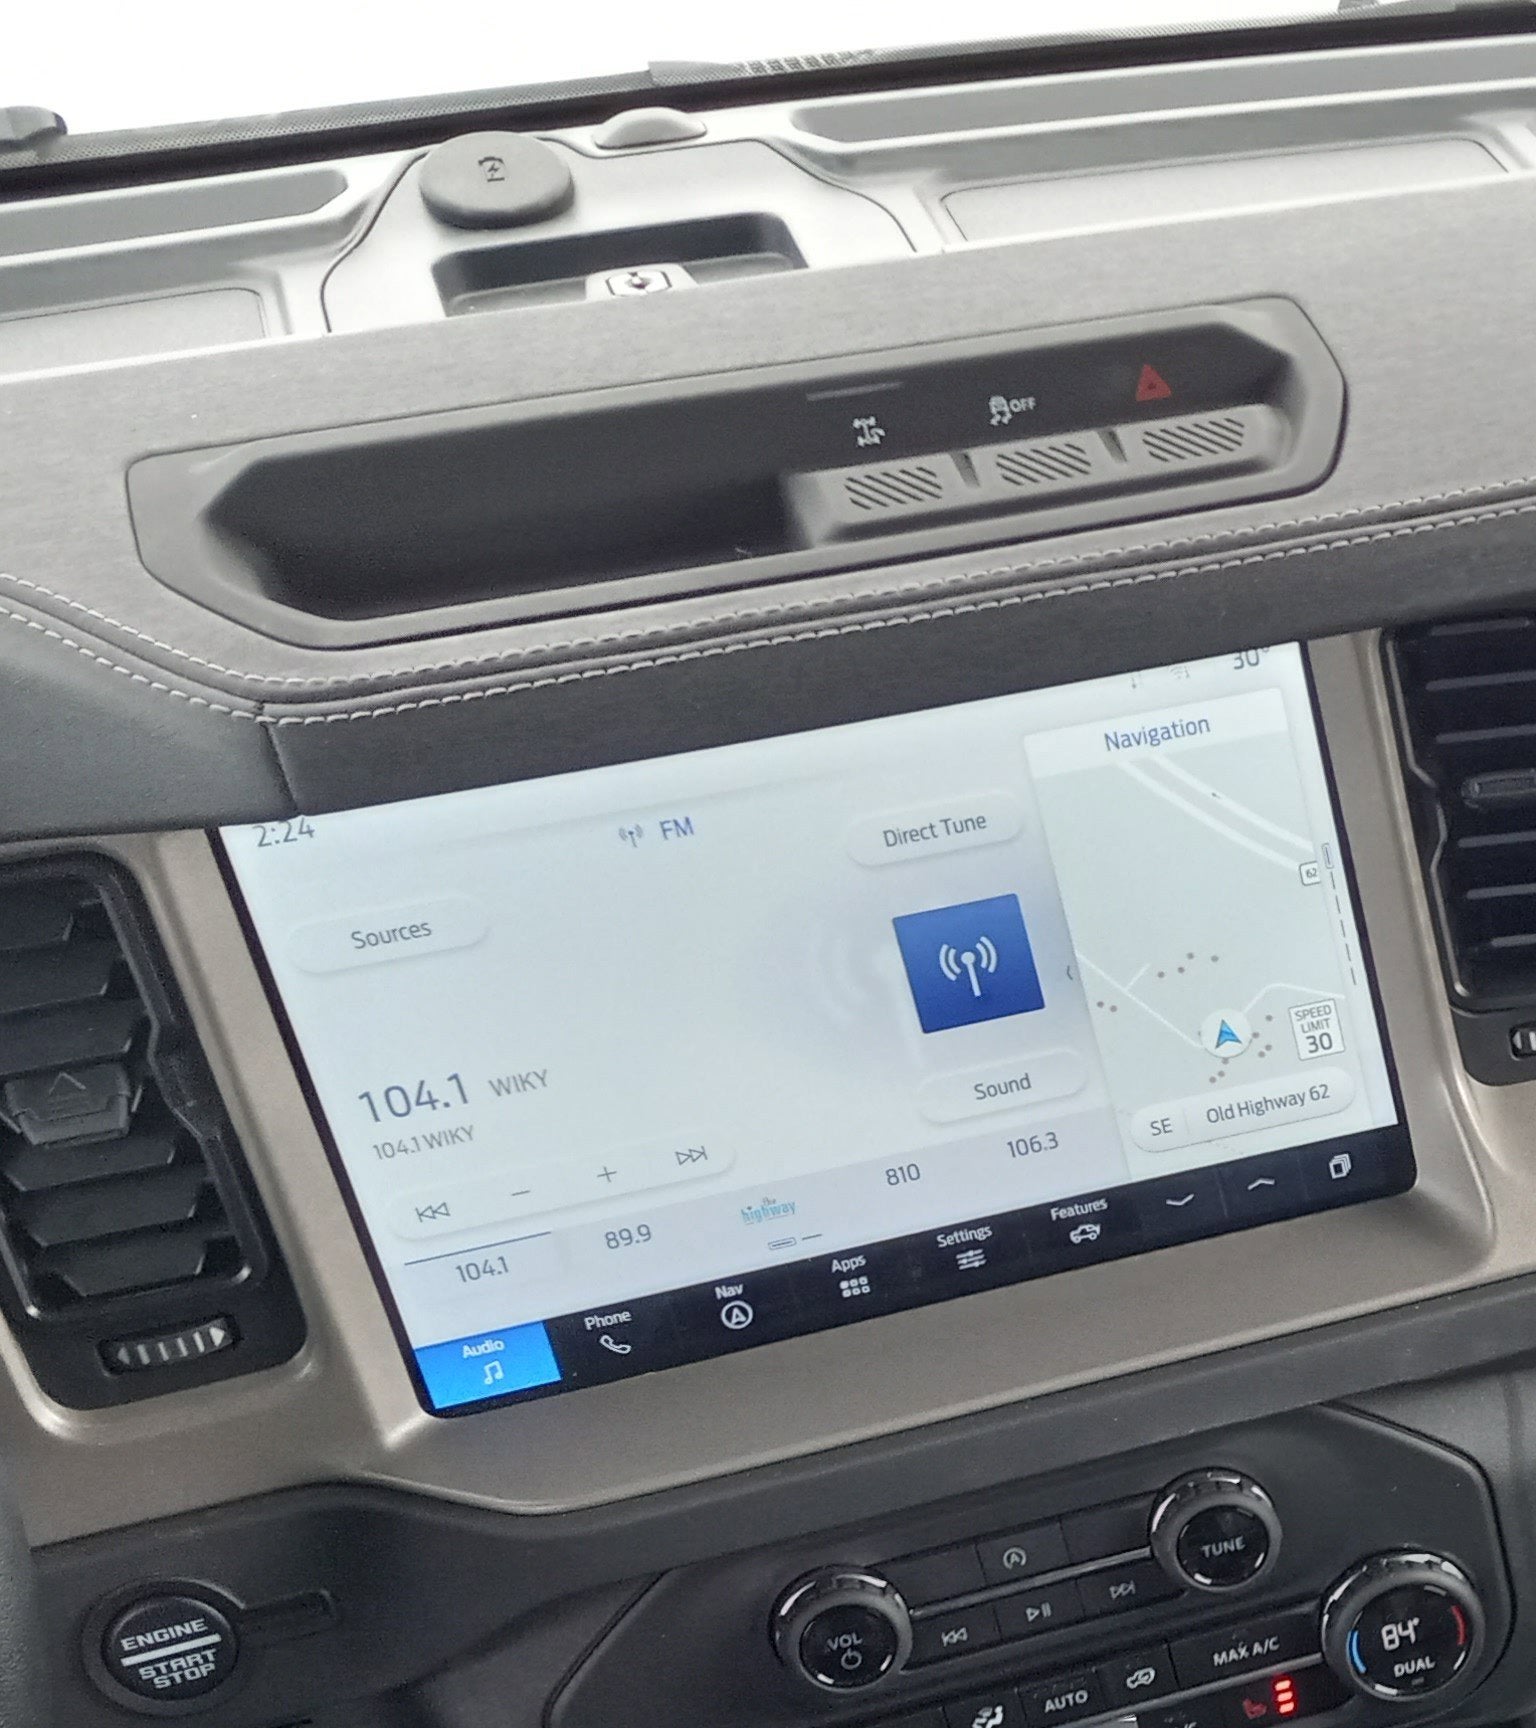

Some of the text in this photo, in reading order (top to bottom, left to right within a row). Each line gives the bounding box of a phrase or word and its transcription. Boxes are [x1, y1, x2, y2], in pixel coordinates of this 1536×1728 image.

[1009, 395, 1036, 415] OFF
[1103, 715, 1211, 751] Navigation
[255, 818, 316, 848] 2:24
[659, 816, 695, 842] FM
[882, 811, 988, 849] Direct Tune
[350, 918, 433, 951] Sources
[1293, 1003, 1333, 1023] SPEED
[1300, 1016, 1332, 1035] LIMIT
[1306, 1032, 1334, 1054] 30
[358, 1068, 548, 1123] 104.1 WIKY
[973, 1072, 1033, 1102] Sound
[1149, 1083, 1331, 1137] SE Old Highway 62
[1005, 1131, 1060, 1160] 106.3
[885, 1162, 921, 1188] 810
[740, 1201, 796, 1223] highway
[1049, 1198, 1109, 1222] Features
[604, 1224, 653, 1251] 89.9
[936, 1223, 993, 1249] Settings
[455, 1255, 509, 1284] 104.1
[831, 1253, 868, 1276] Apps
[714, 1281, 744, 1301] Nav
[584, 1308, 632, 1332] Phone
[461, 1336, 506, 1360] Audio
[1201, 1536, 1246, 1558] TUNE
[120, 1617, 208, 1651] ENGINE
[826, 1633, 863, 1653] VOL
[1212, 1635, 1281, 1667] MAX A/C
[138, 1648, 217, 1681] START
[152, 1663, 216, 1690] STOP
[1393, 1656, 1436, 1679] DUAL
[1044, 1688, 1089, 1714] AUTO
